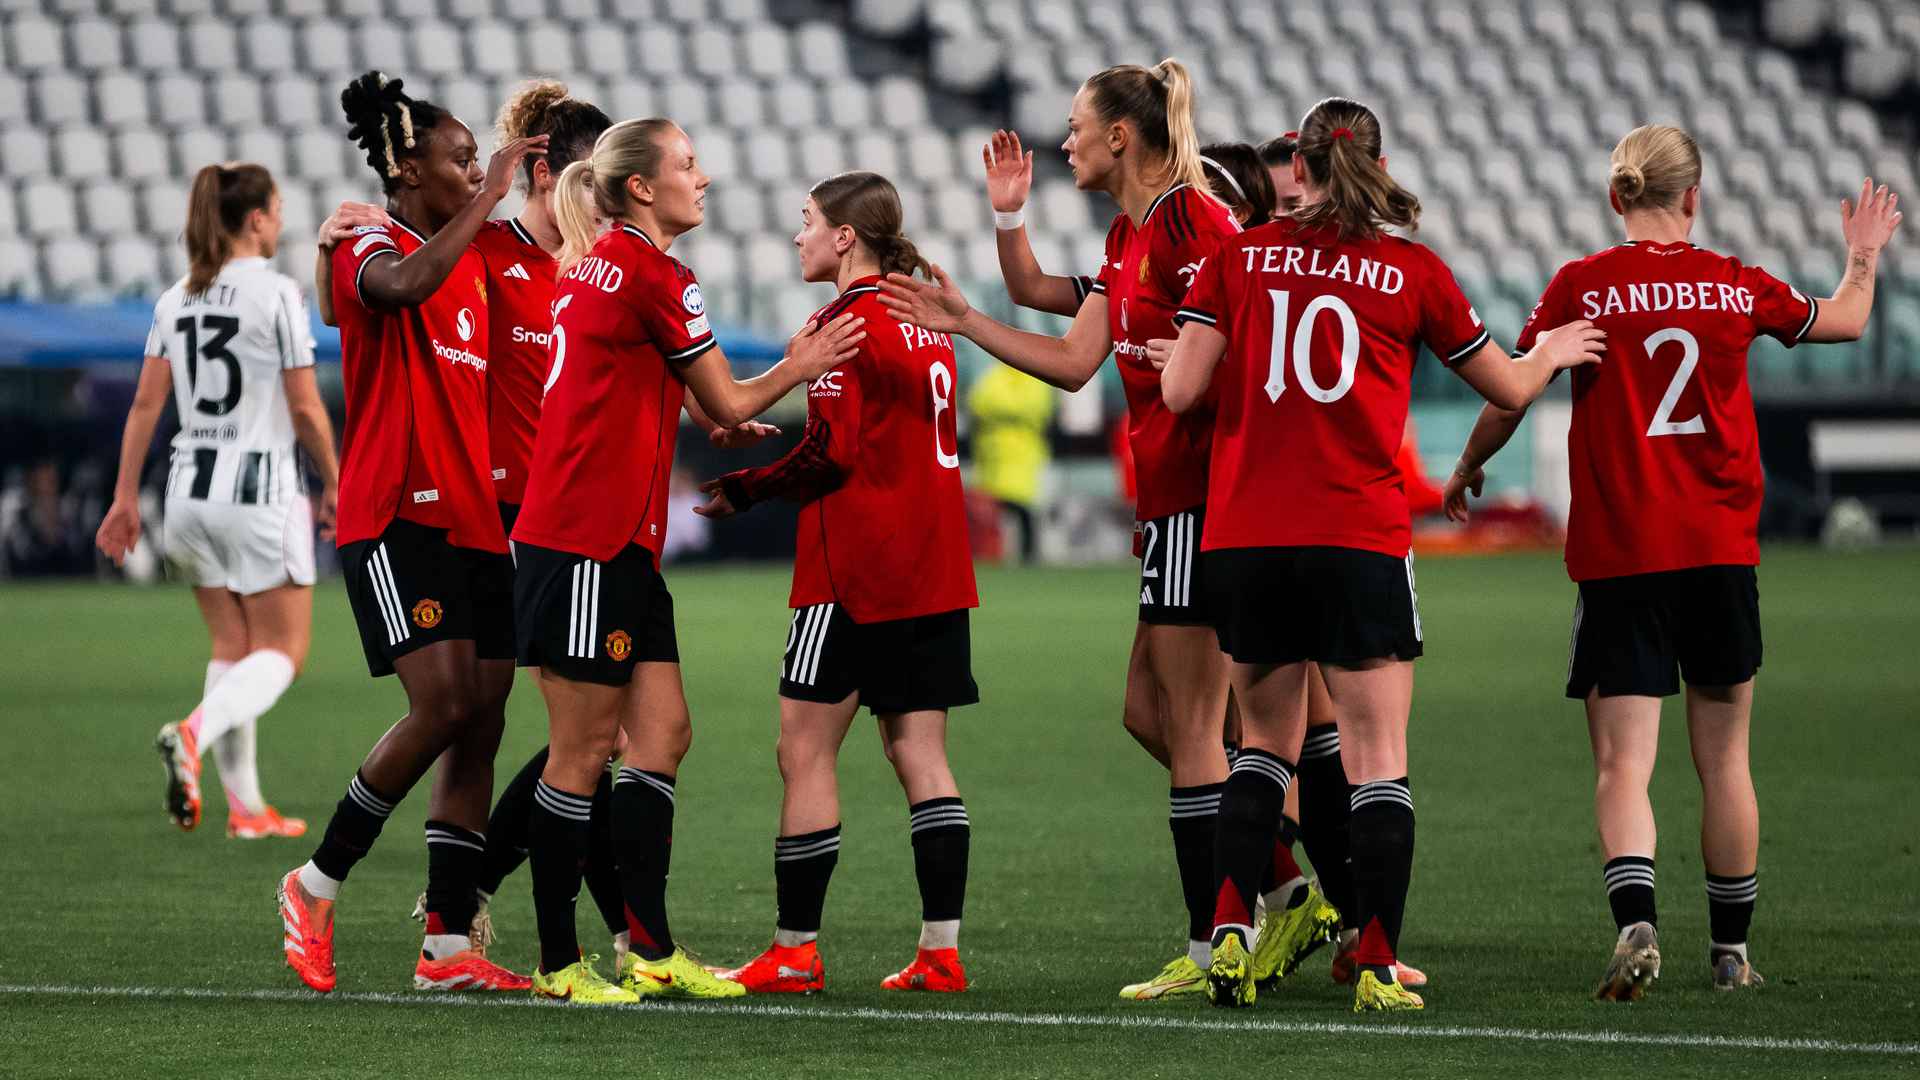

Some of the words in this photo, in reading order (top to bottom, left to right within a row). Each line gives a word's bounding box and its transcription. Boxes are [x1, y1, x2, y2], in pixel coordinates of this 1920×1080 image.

[564, 256, 624, 294] SUND
[1241, 246, 1404, 295] TERLAND
[1582, 282, 1755, 321] SANDBERG
[175, 314, 242, 416] 13
[1263, 288, 1361, 404] 10
[1643, 327, 1707, 436] 2
[929, 360, 959, 469] 8
